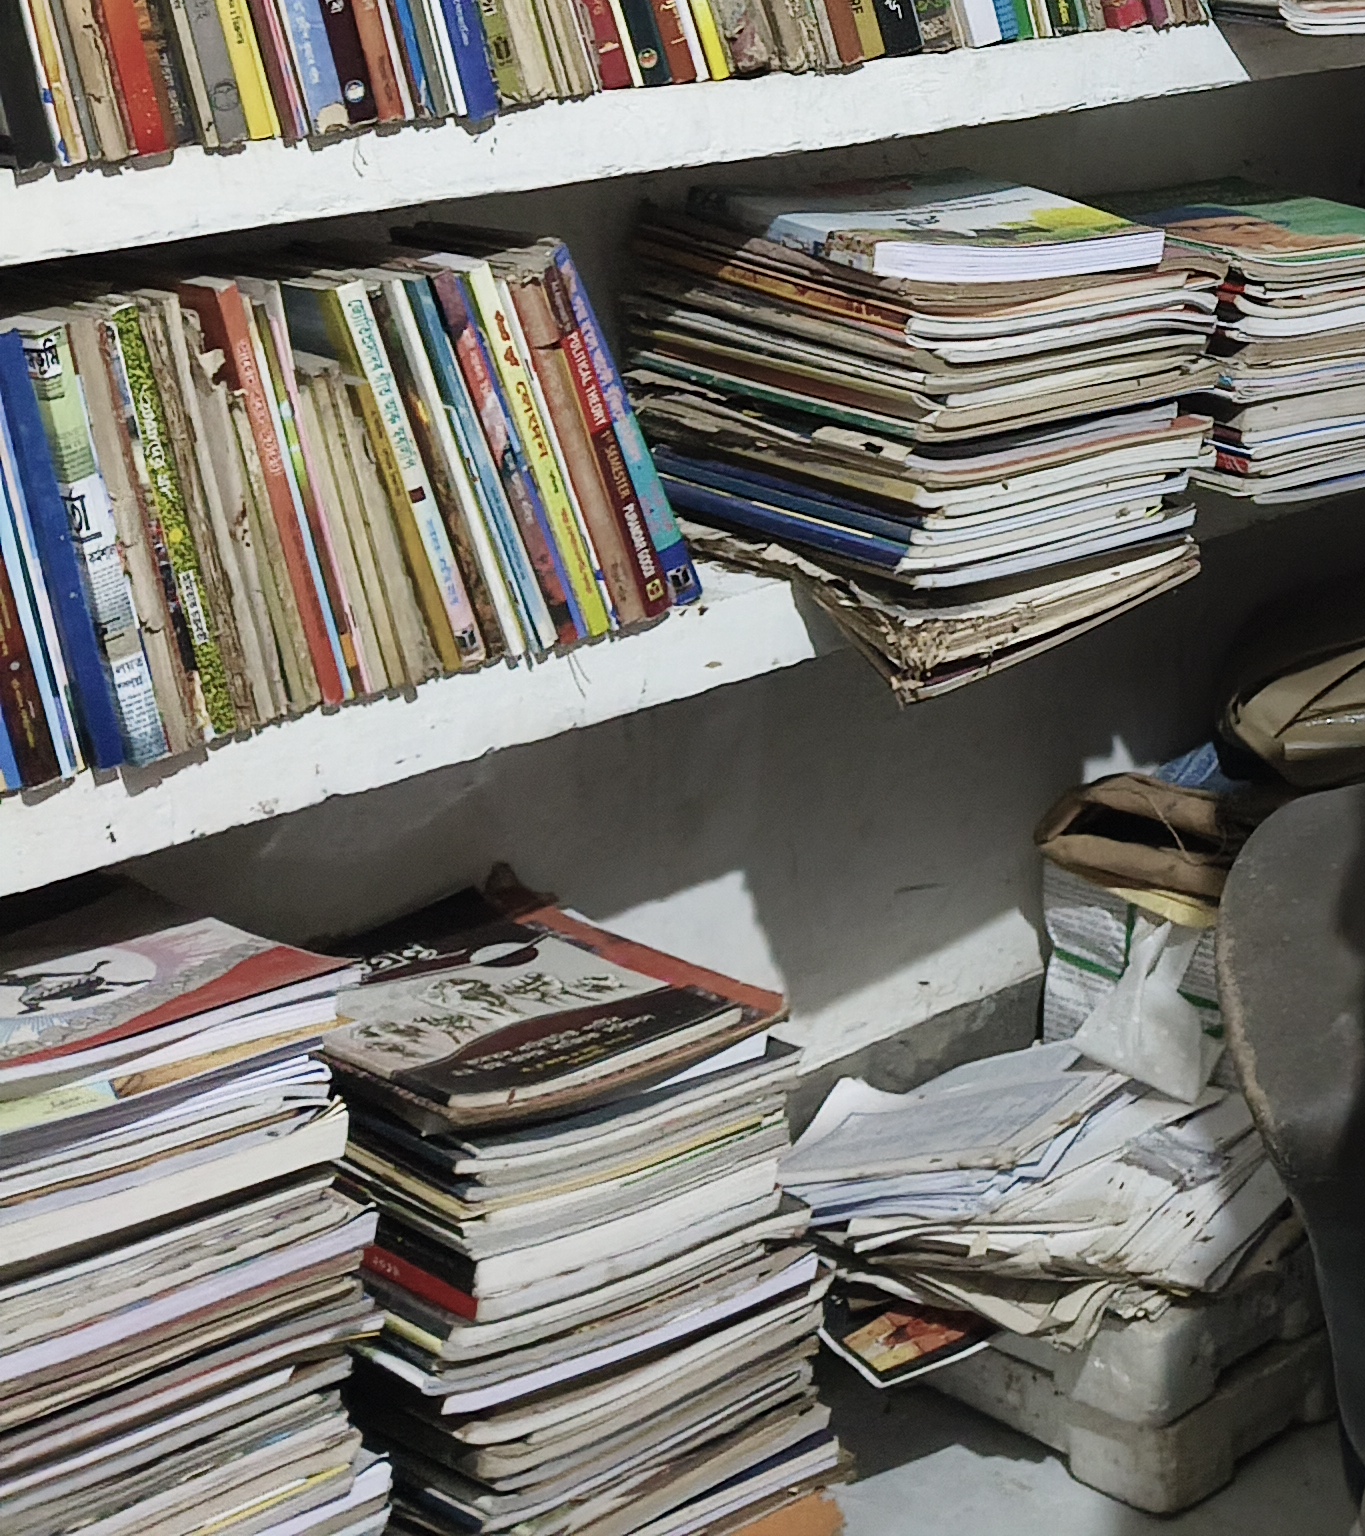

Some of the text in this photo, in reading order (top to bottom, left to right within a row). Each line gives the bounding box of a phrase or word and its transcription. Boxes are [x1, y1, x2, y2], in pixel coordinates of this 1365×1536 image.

[565, 331, 608, 426] POLITICAL THEORY
[602, 443, 632, 499] SEMESTER
